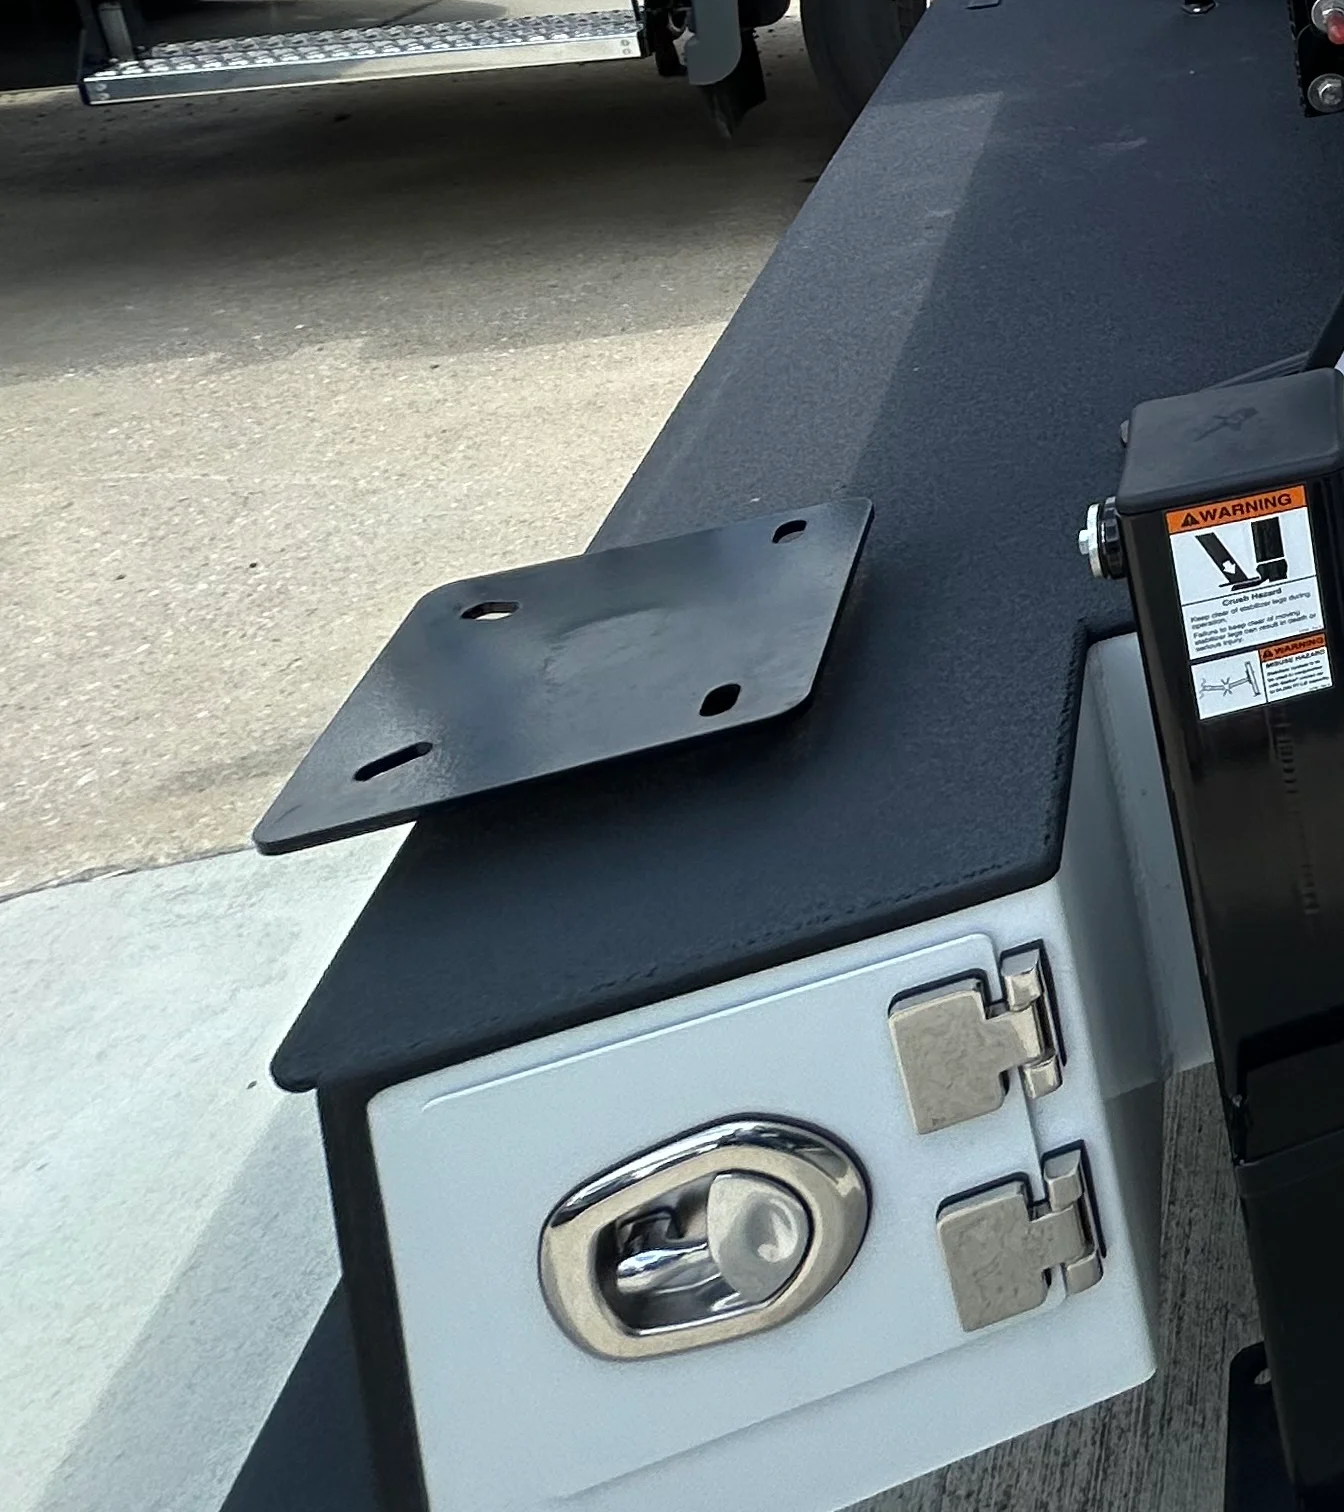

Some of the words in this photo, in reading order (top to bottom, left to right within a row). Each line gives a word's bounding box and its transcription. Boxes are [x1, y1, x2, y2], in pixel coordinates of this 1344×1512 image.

[1199, 493, 1292, 522] WARNING
[1222, 595, 1250, 606] Crush
[1250, 587, 1282, 599] Hazard
[1275, 635, 1324, 655] WARNING
